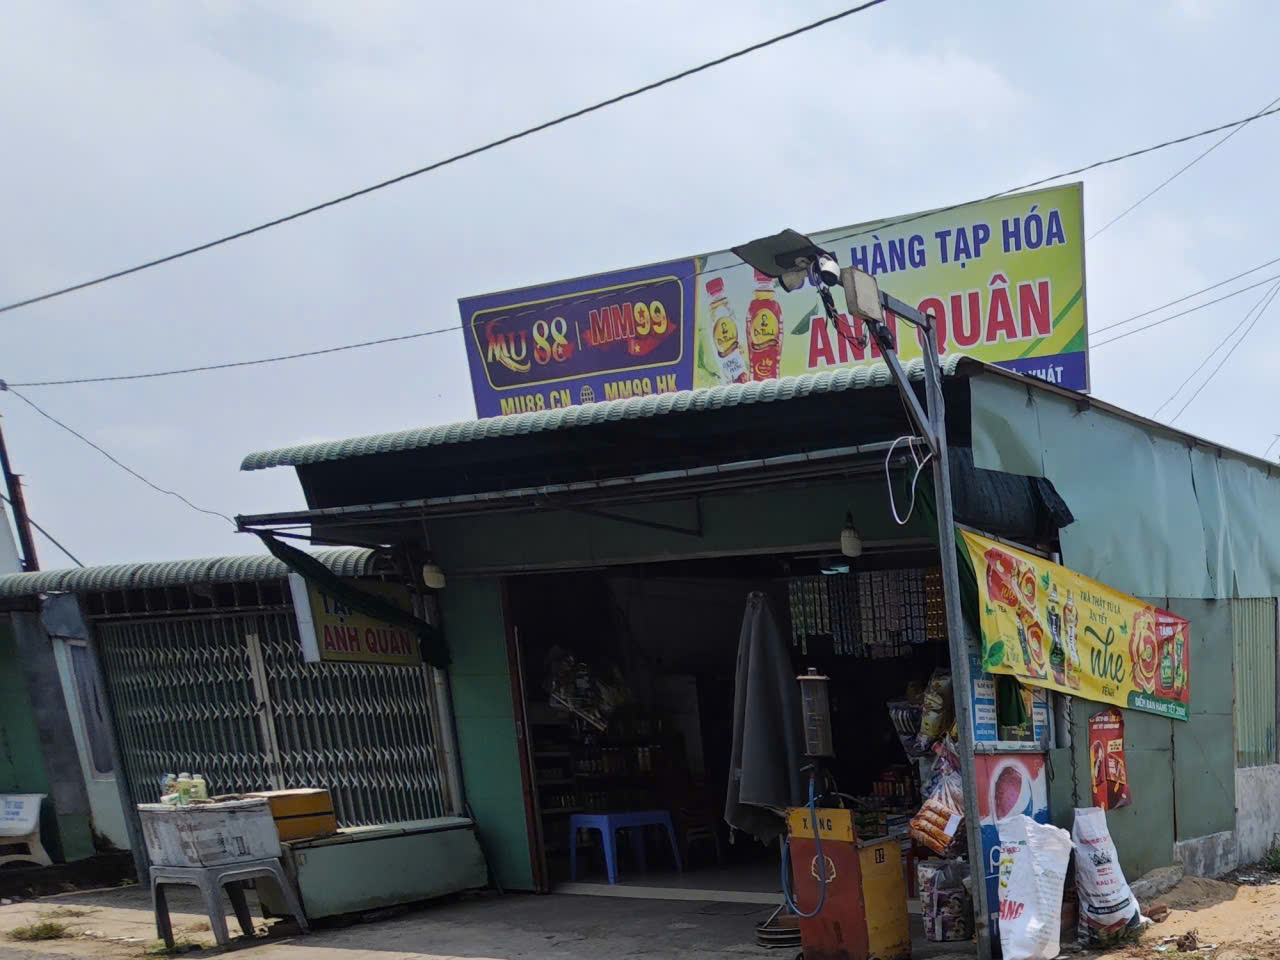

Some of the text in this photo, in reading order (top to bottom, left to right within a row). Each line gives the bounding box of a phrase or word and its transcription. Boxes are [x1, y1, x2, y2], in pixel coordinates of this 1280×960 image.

[851, 234, 926, 276] HÀNG
[935, 223, 990, 268] TẠP
[1002, 205, 1065, 253] HÓA
[589, 300, 667, 345] MM99
[916, 274, 1051, 355] QUÂN
[323, 624, 361, 652] ANH
[1084, 625, 1126, 690] nhẹ
[802, 817, 832, 831] XNG
